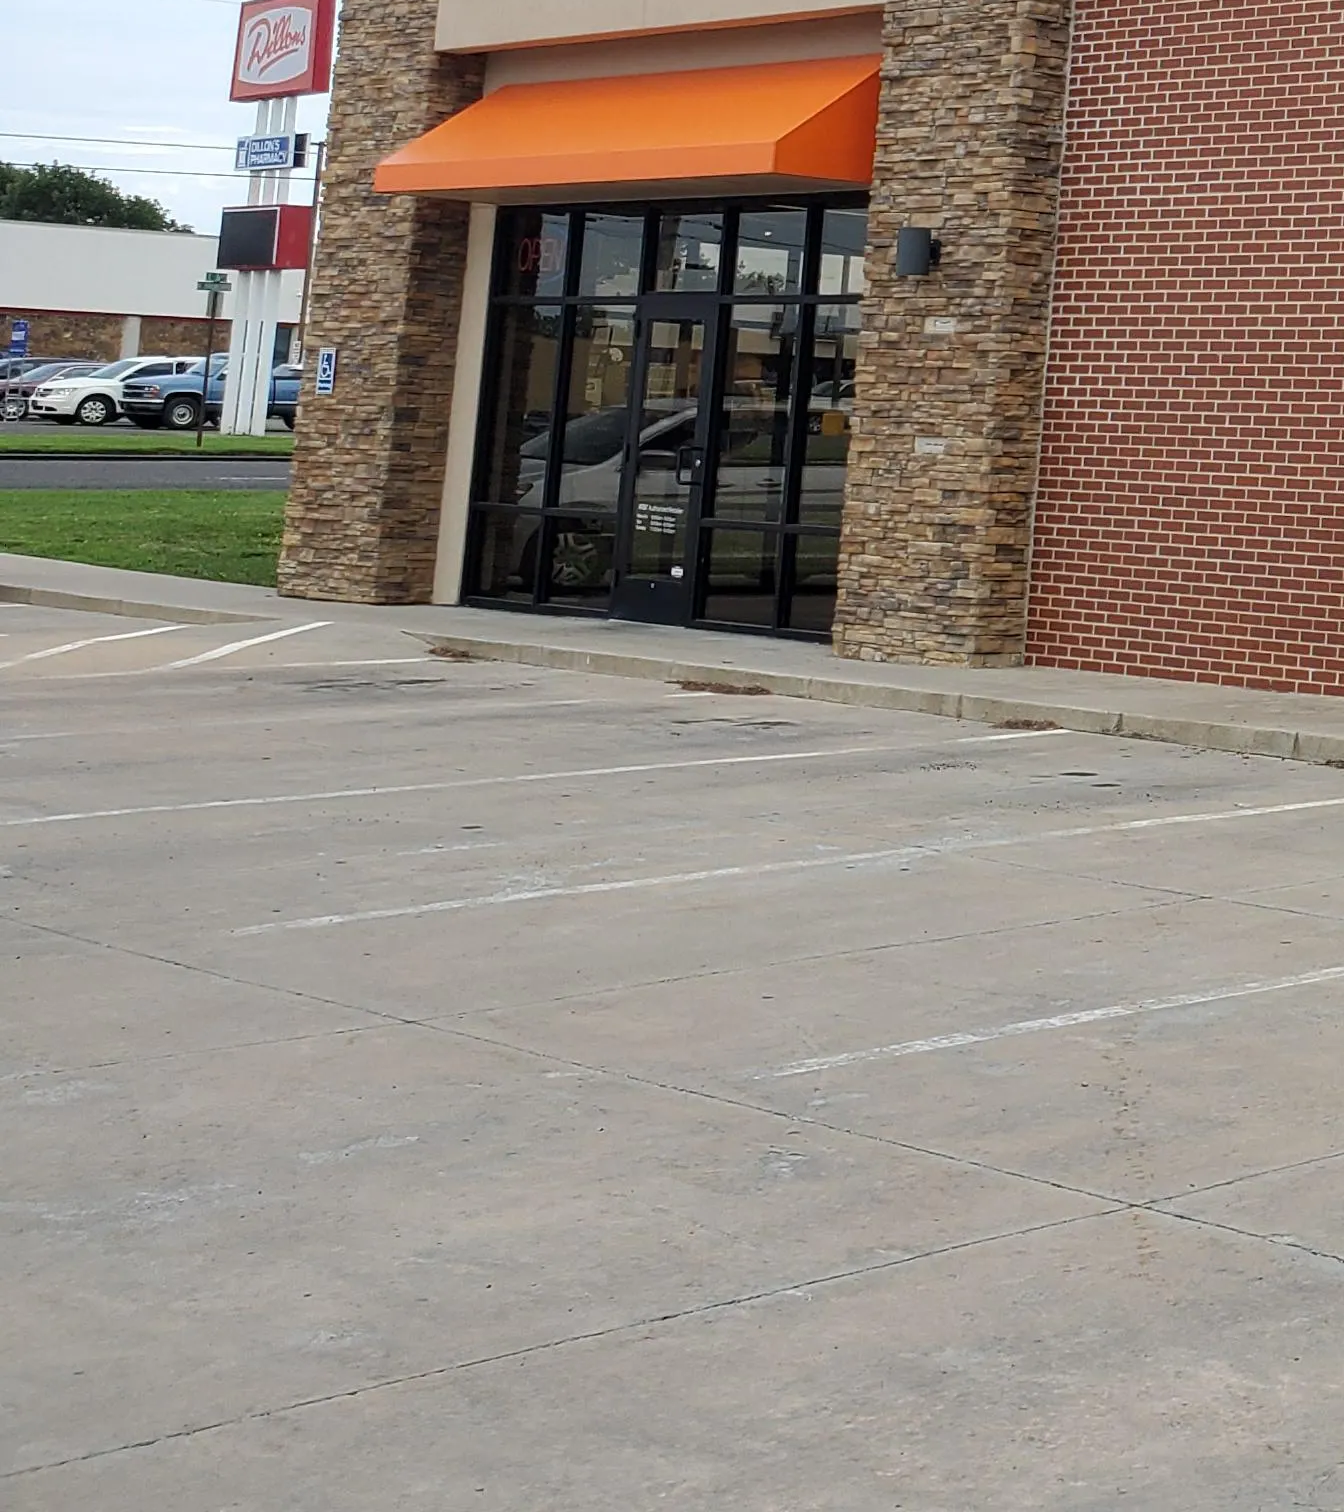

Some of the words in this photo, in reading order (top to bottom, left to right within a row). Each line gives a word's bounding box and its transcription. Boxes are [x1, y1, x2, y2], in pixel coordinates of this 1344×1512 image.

[247, 13, 307, 74] Dillons
[248, 151, 288, 167] PHARMACY
[517, 237, 563, 272] OPEN
